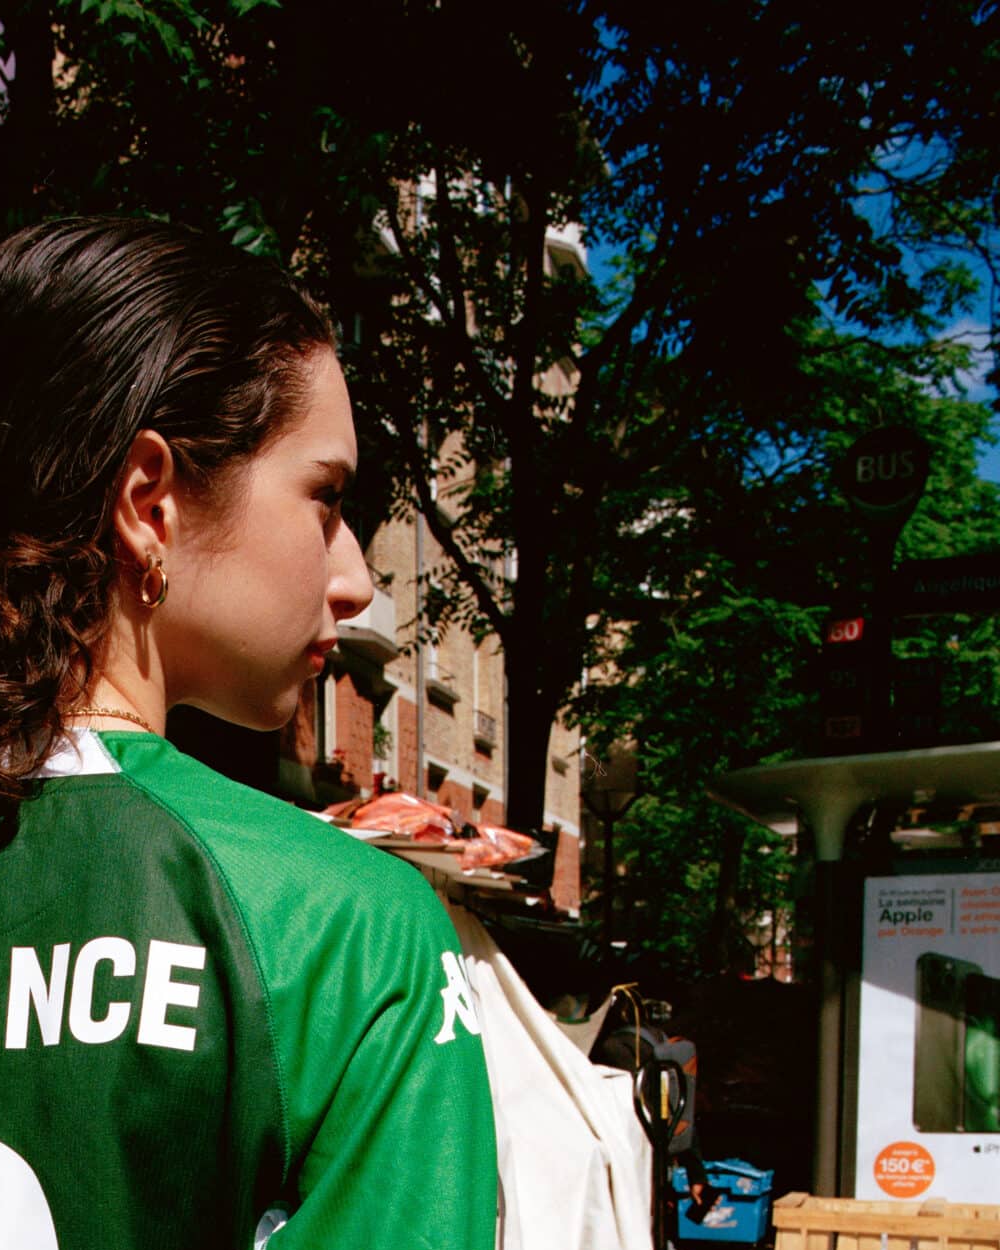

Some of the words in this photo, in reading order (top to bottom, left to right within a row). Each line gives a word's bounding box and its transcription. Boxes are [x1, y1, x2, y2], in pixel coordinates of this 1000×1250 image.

[856, 451, 914, 483] BUS
[878, 898, 893, 908] La
[896, 896, 946, 907] semaine
[879, 907, 934, 926] Apple
